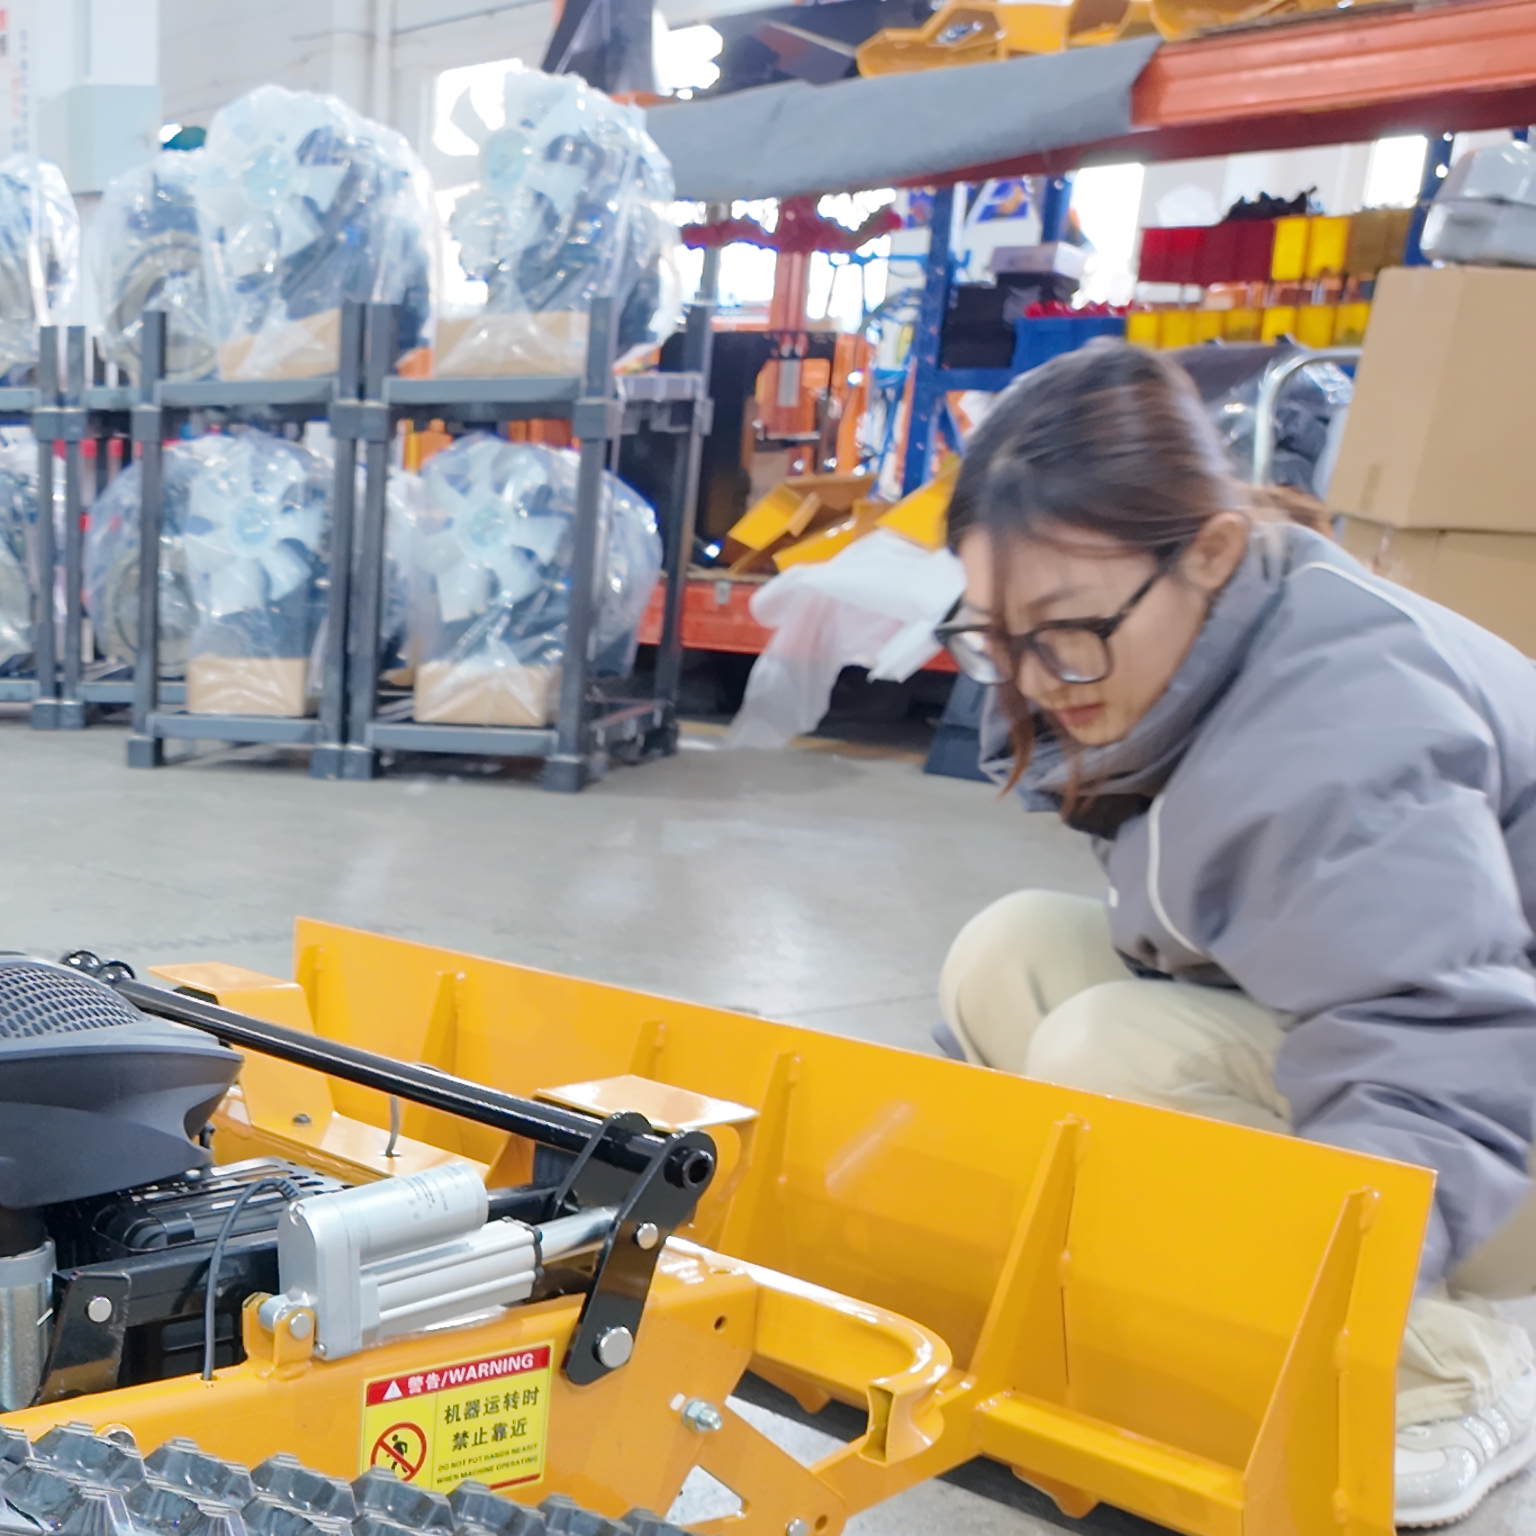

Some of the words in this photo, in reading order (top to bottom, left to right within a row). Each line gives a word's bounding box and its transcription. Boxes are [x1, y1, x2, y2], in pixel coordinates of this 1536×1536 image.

[444, 1386, 540, 1425] 机器运转时
[451, 1417, 528, 1453] 禁止靠近
[451, 1459, 466, 1469] NOT
[468, 1455, 482, 1465] PUT
